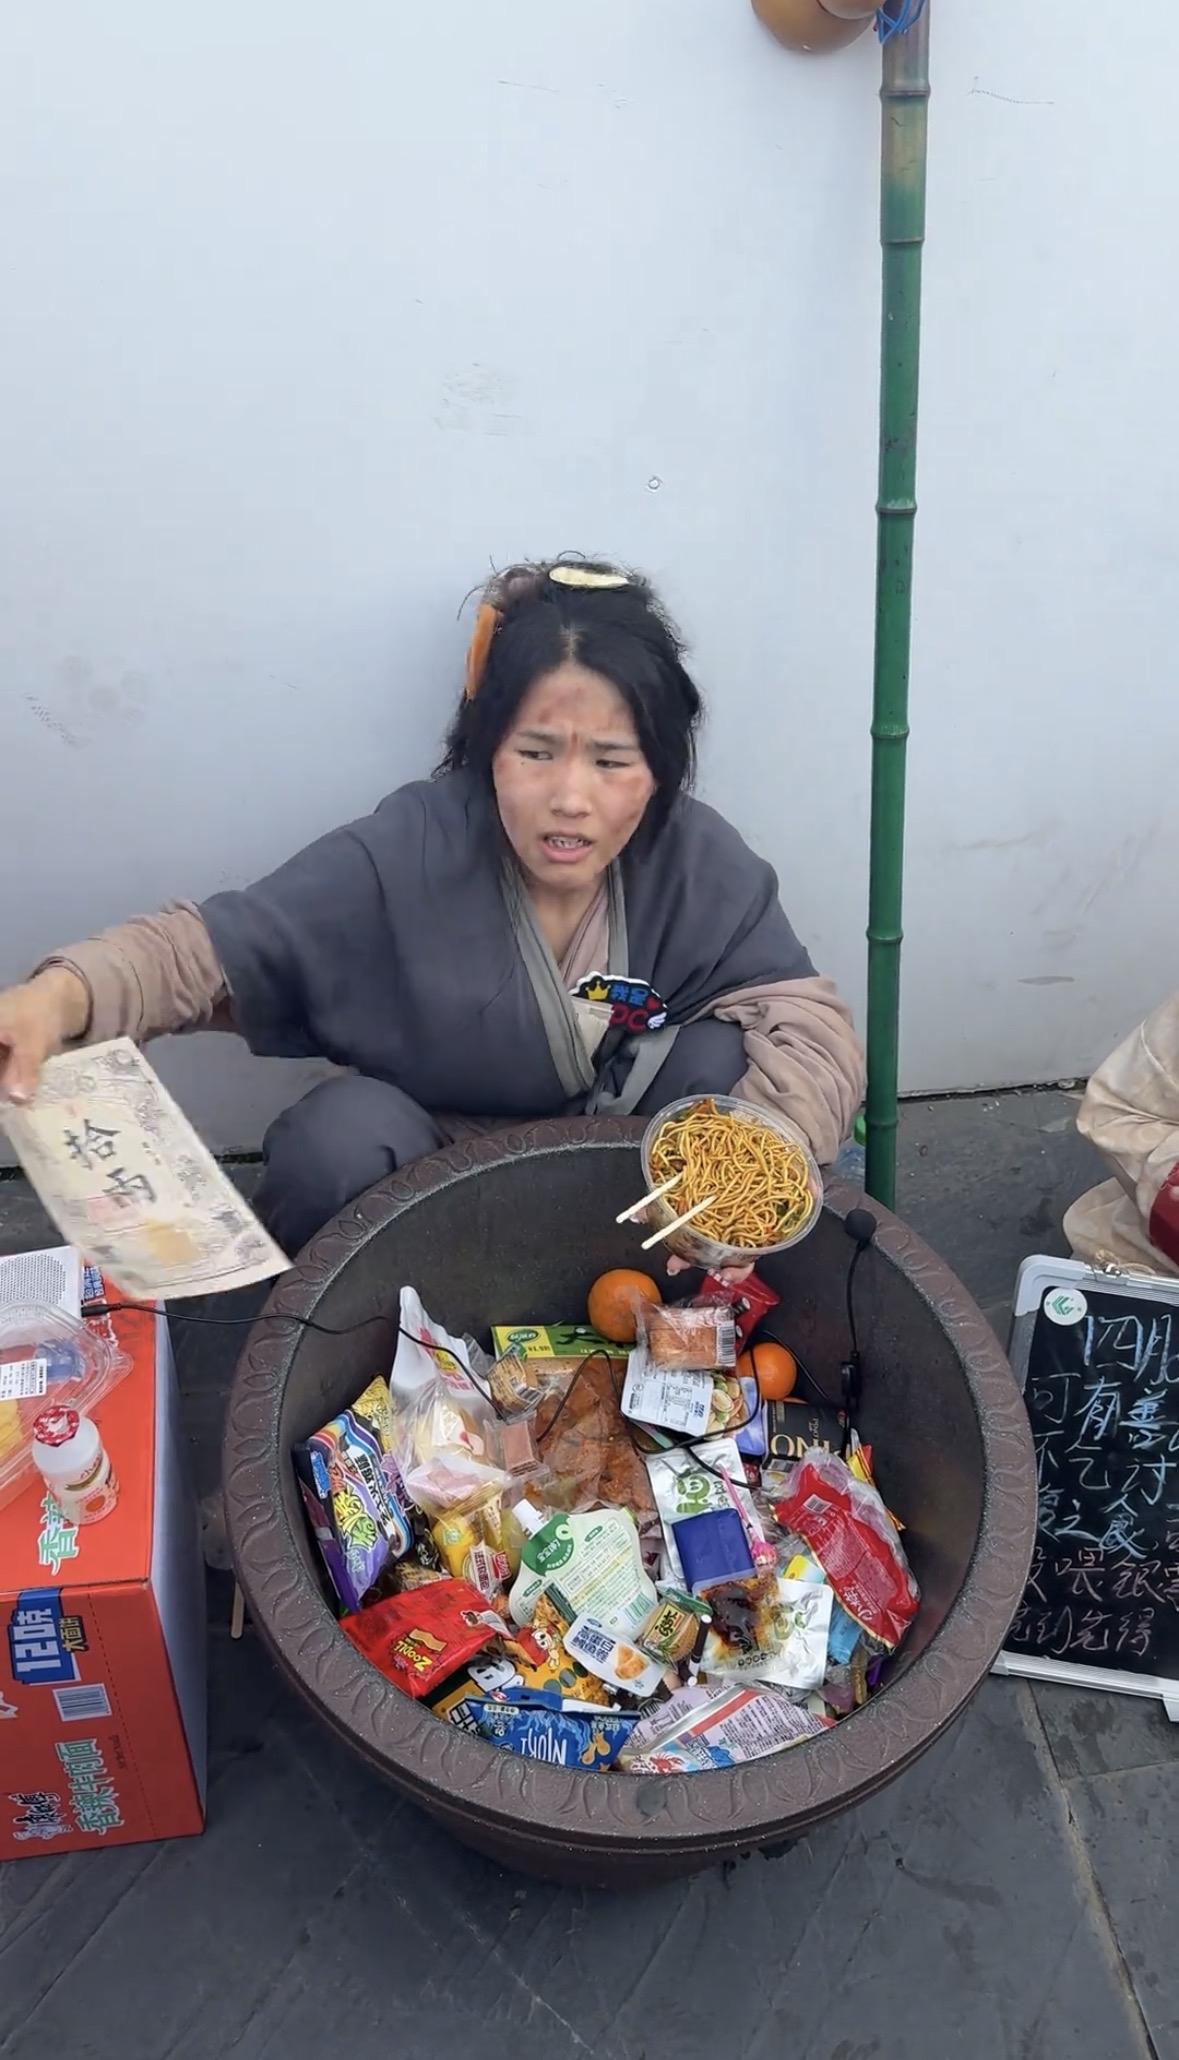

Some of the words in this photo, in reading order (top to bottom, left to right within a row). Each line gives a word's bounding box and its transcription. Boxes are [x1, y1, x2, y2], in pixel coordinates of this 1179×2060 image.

[14, 1607, 62, 1674] 120克
[55, 1739, 124, 1835] 香辣牛肉面
